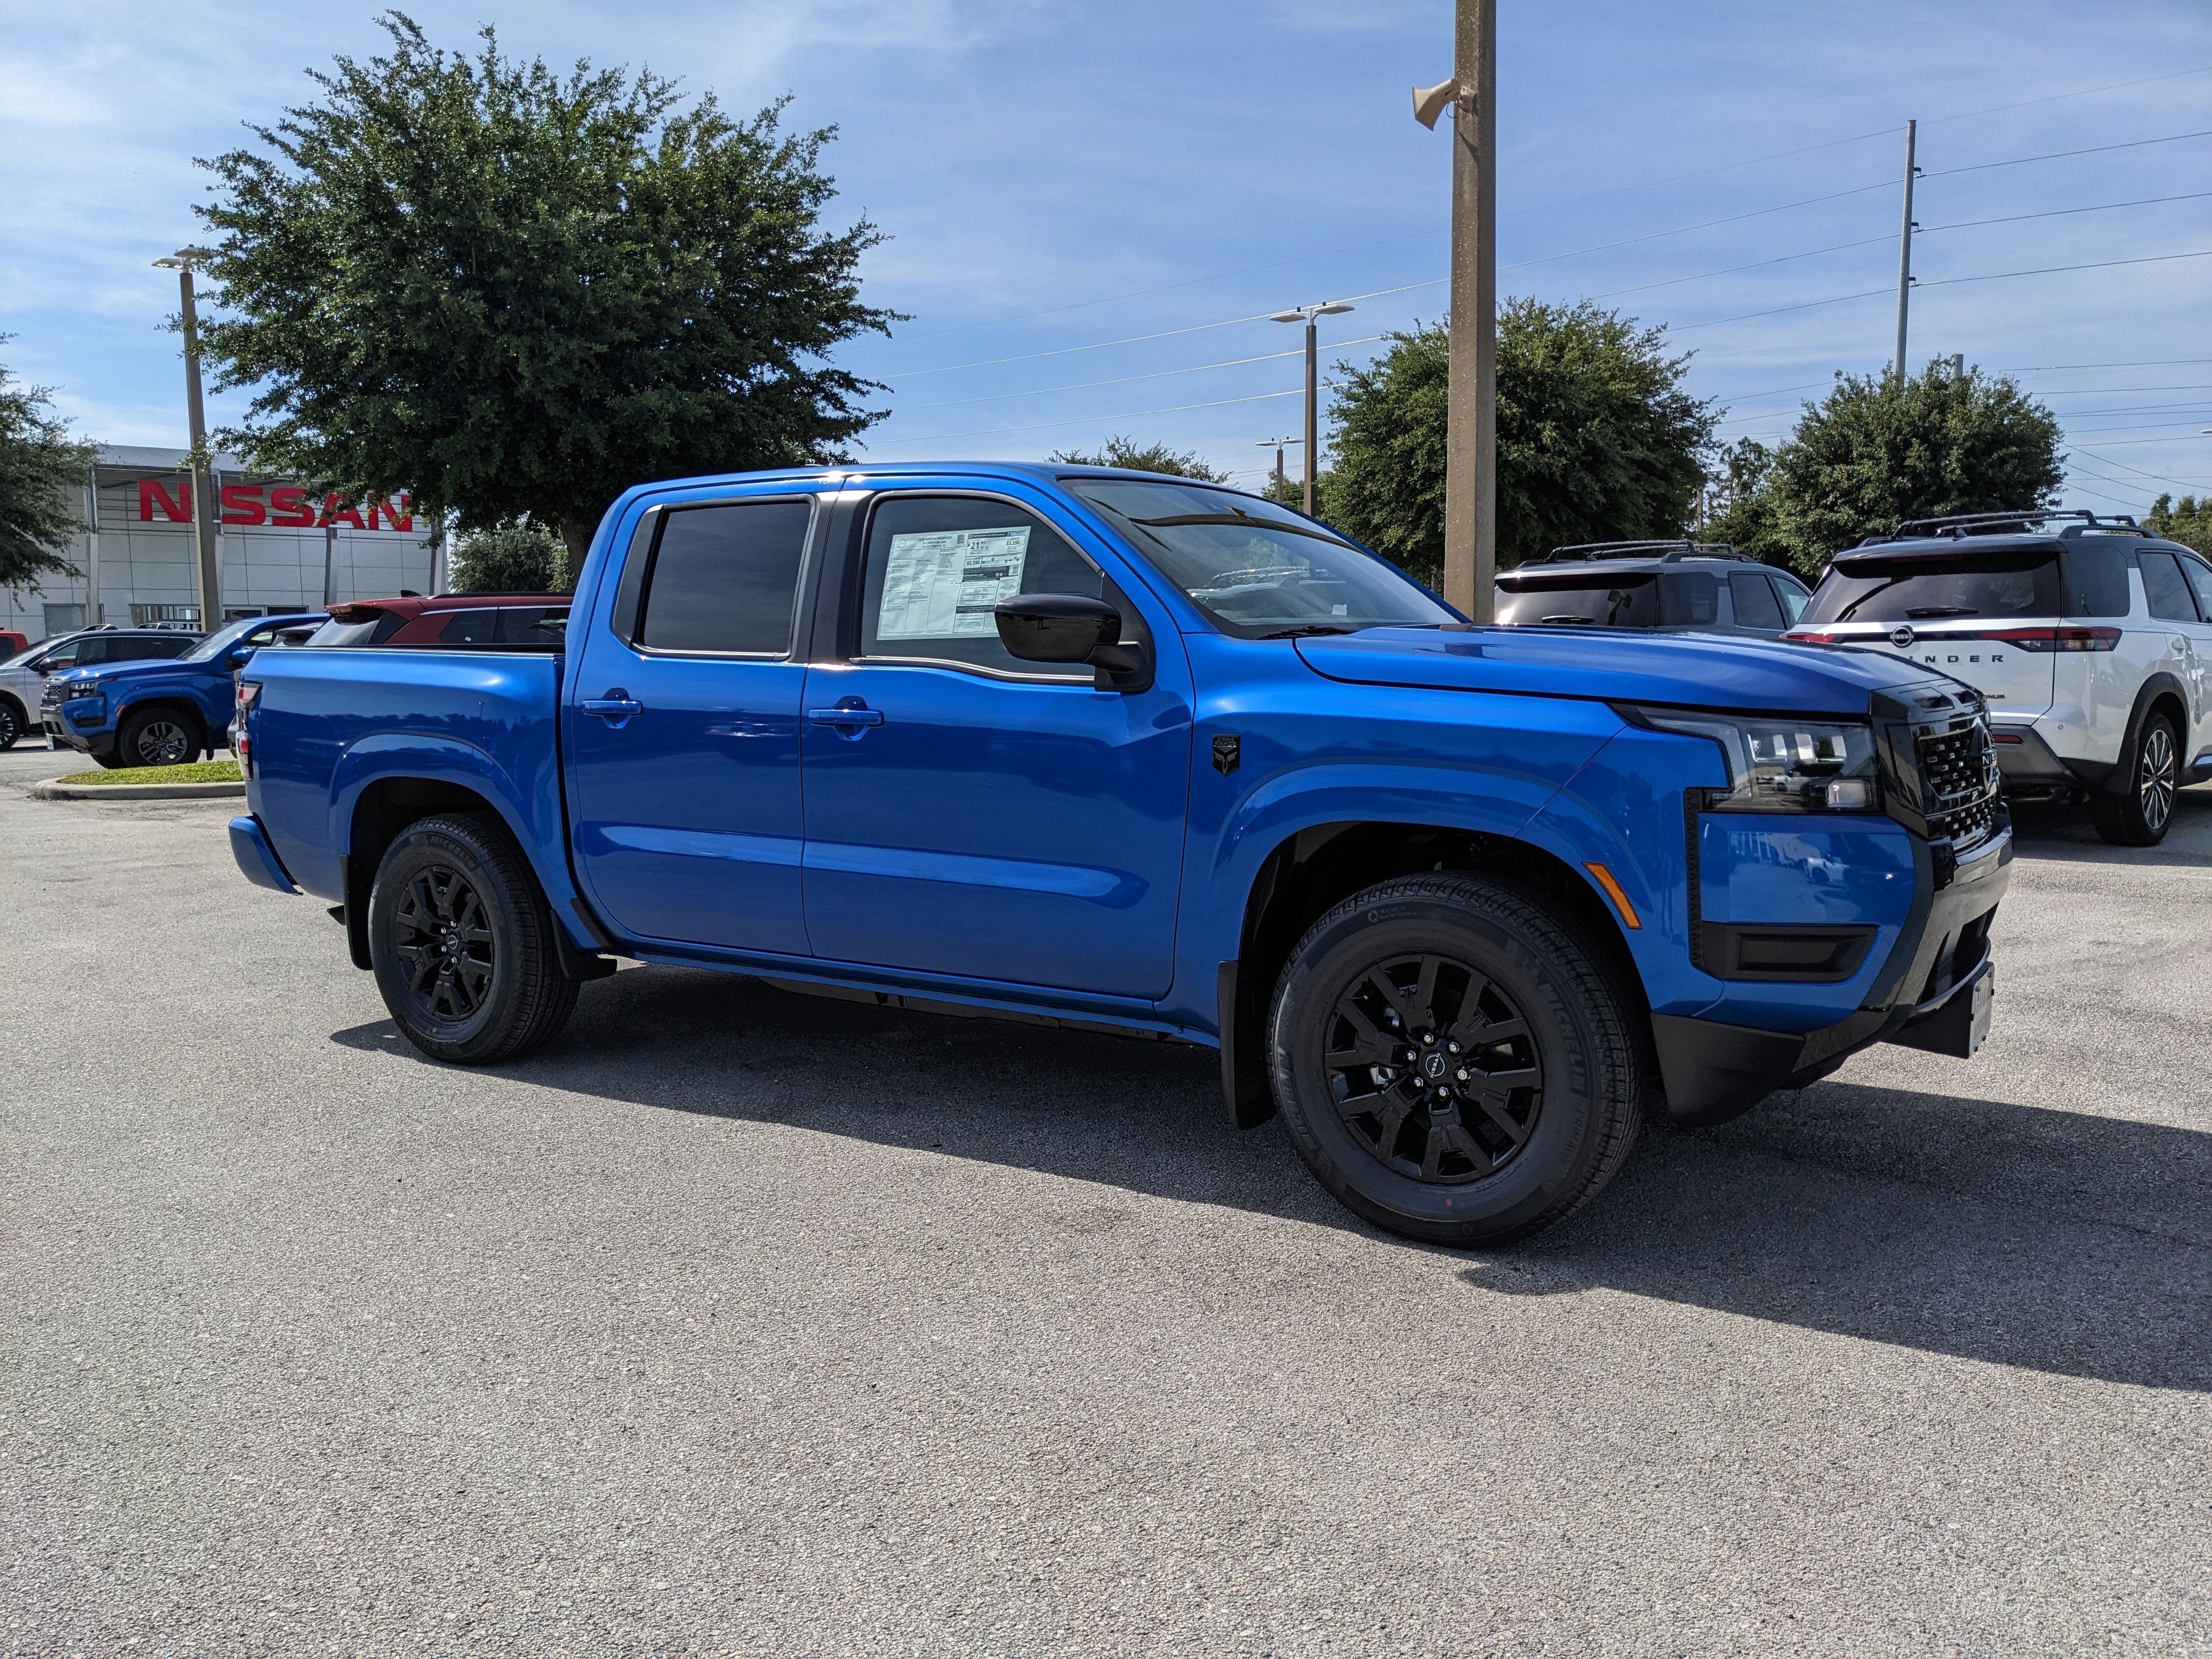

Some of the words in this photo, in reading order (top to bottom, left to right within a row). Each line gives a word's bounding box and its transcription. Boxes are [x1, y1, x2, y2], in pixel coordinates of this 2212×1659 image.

[138, 480, 413, 532] NSSAN
[970, 541, 979, 550] 21
[1538, 981, 1589, 1098] MICHELIN
[1430, 1052, 1441, 1079] NISSAN
